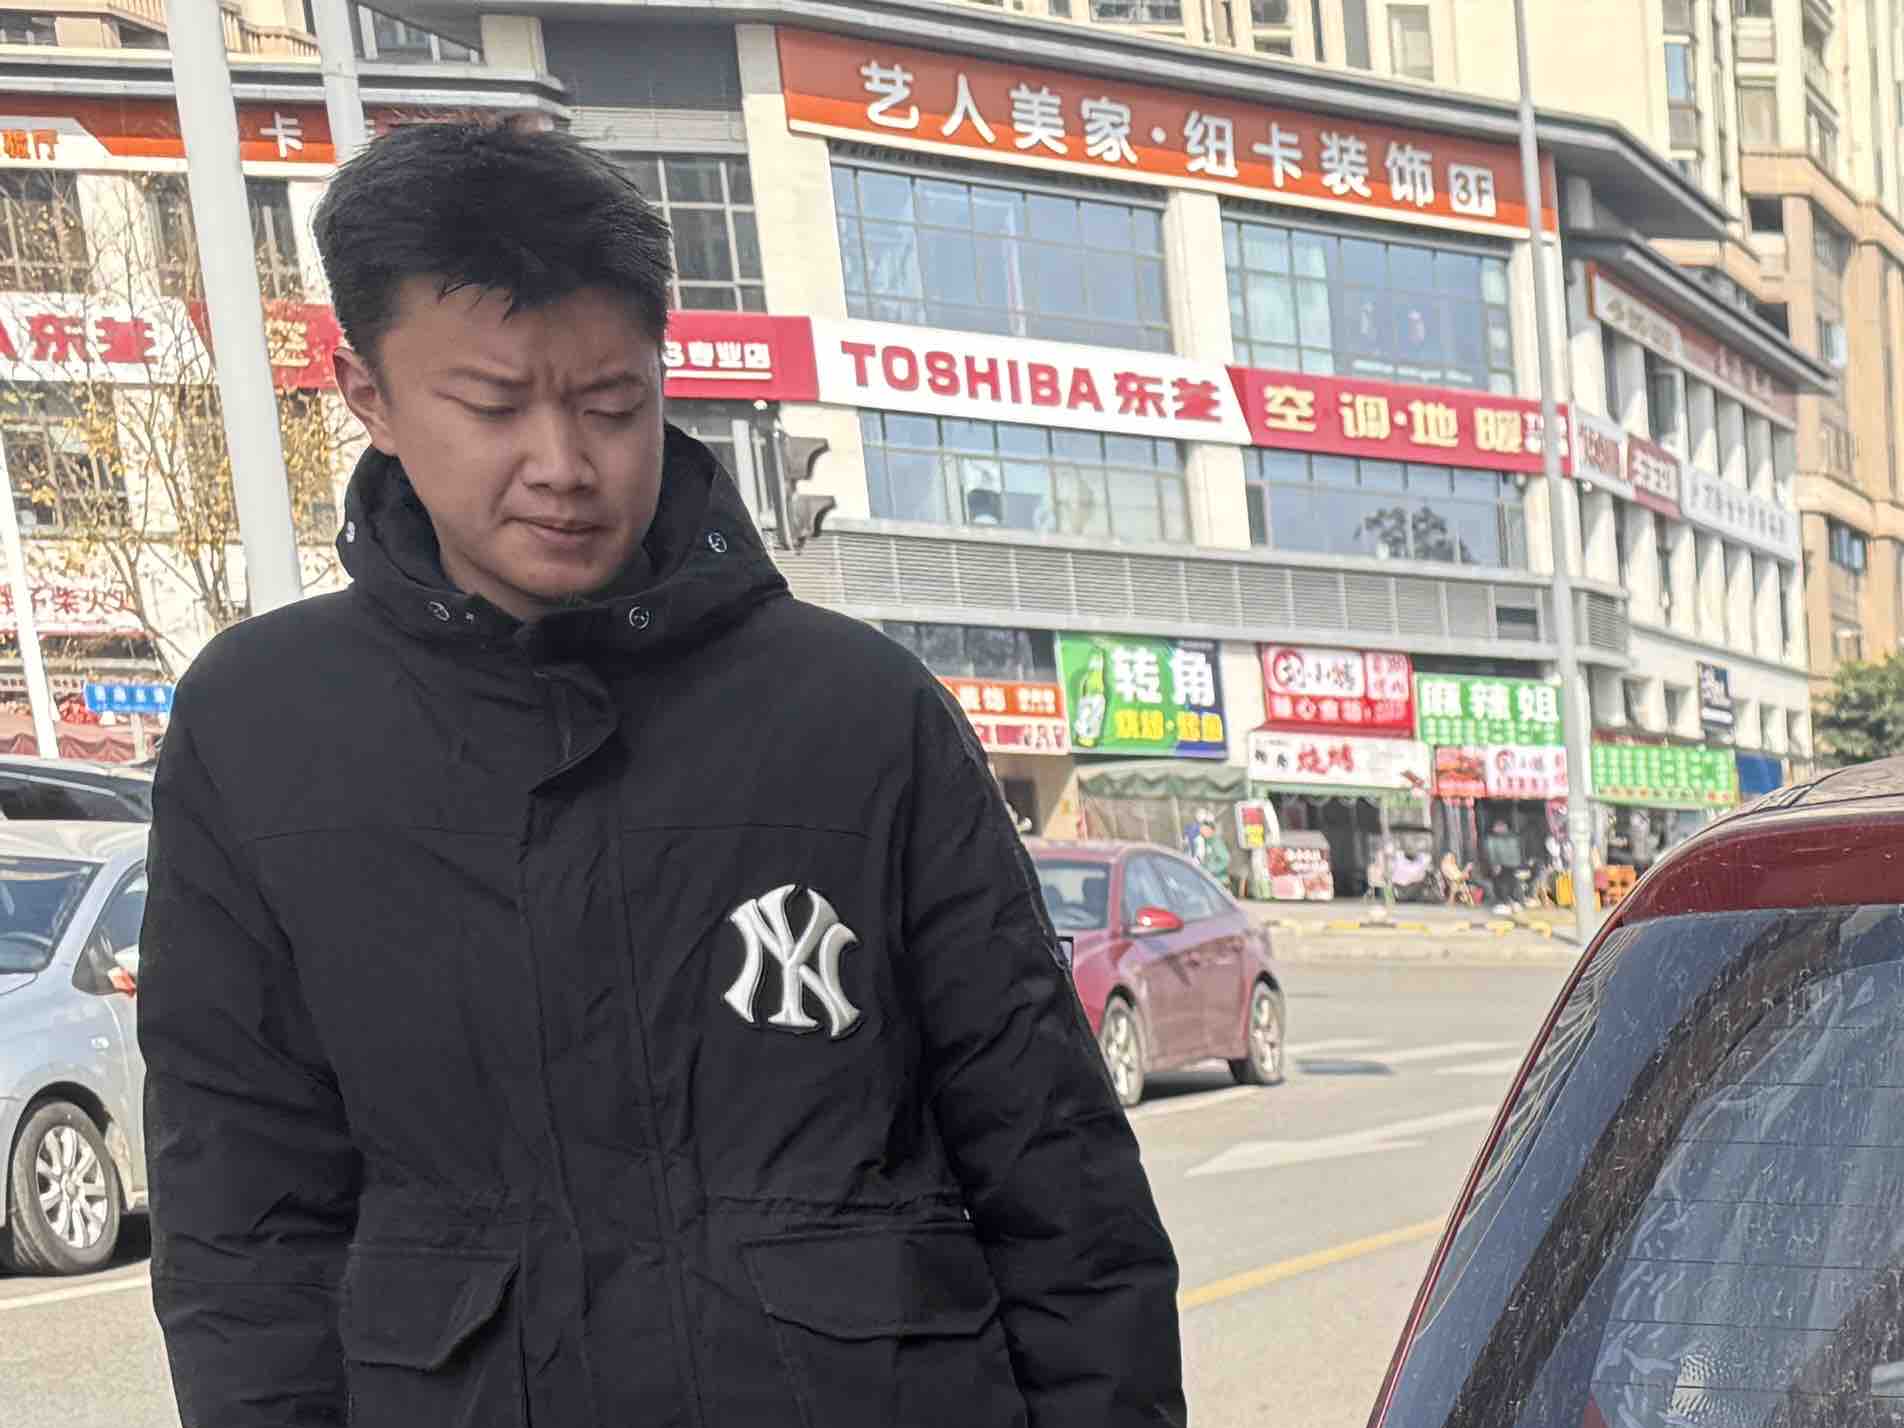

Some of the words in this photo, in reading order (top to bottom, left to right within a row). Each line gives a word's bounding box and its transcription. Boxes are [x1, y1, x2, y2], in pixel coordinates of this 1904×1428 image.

[860, 60, 1435, 208] 艺人美家·纽卡装饰
[1454, 170, 1490, 208] 3F
[840, 339, 1105, 414] TOSHIBA
[1113, 371, 1223, 423] 东芝
[1263, 383, 1522, 455] 空调·地暖
[1113, 645, 1216, 706] 转角
[1419, 680, 1560, 722] 麻辣姐
